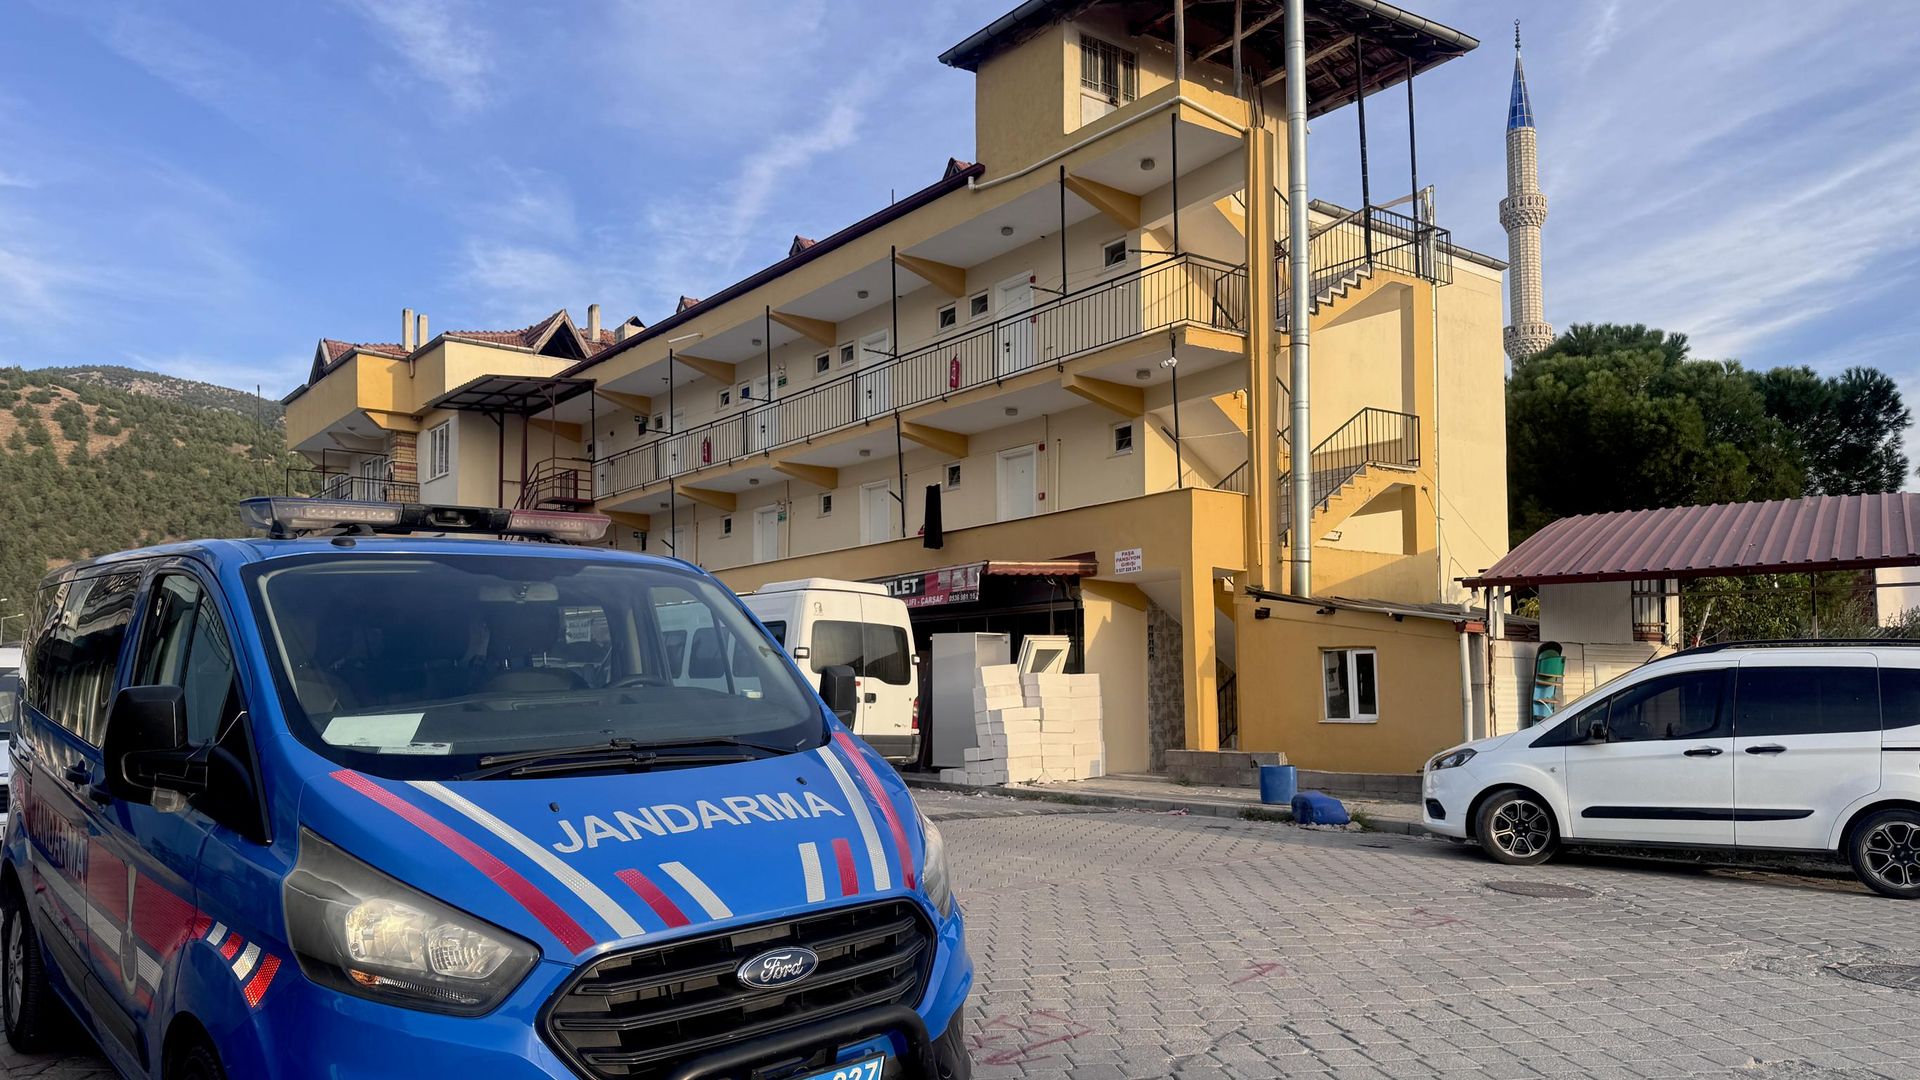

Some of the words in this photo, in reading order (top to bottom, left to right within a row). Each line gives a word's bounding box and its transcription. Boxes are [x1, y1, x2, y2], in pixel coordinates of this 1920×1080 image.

[884, 578, 919, 596] TLET
[32, 798, 88, 886] JANDARMA
[552, 791, 845, 853] JANDARMA
[760, 954, 804, 982] Ford
